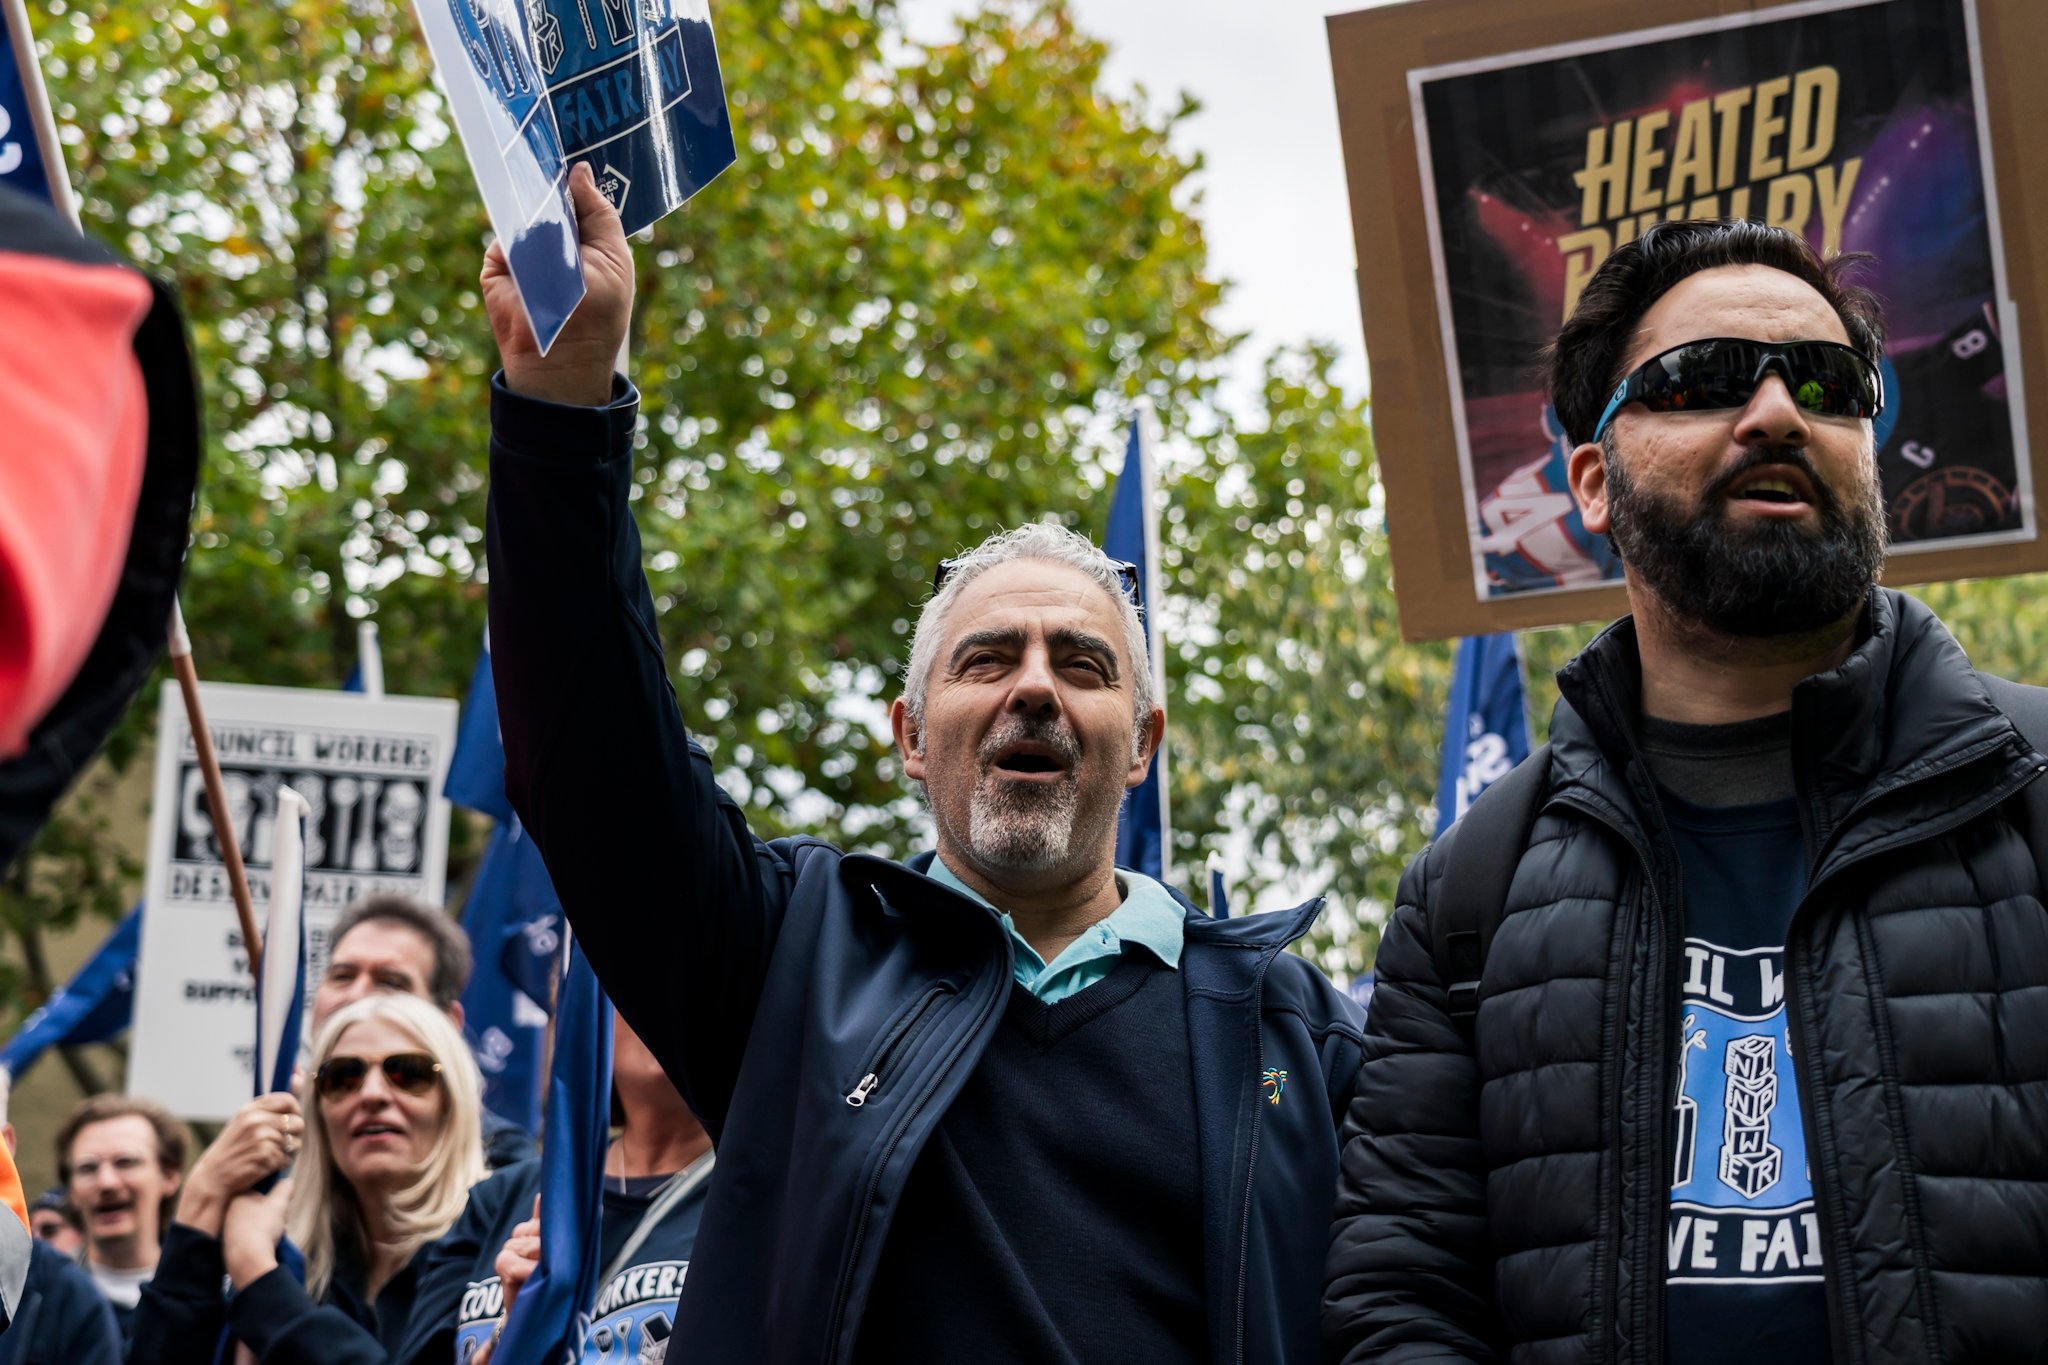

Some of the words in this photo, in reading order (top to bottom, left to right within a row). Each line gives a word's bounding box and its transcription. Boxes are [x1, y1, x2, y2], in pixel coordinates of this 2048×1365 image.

[557, 68, 641, 146] FAIR
[1573, 65, 1840, 227] HEATED
[313, 733, 432, 770] WORKERS
